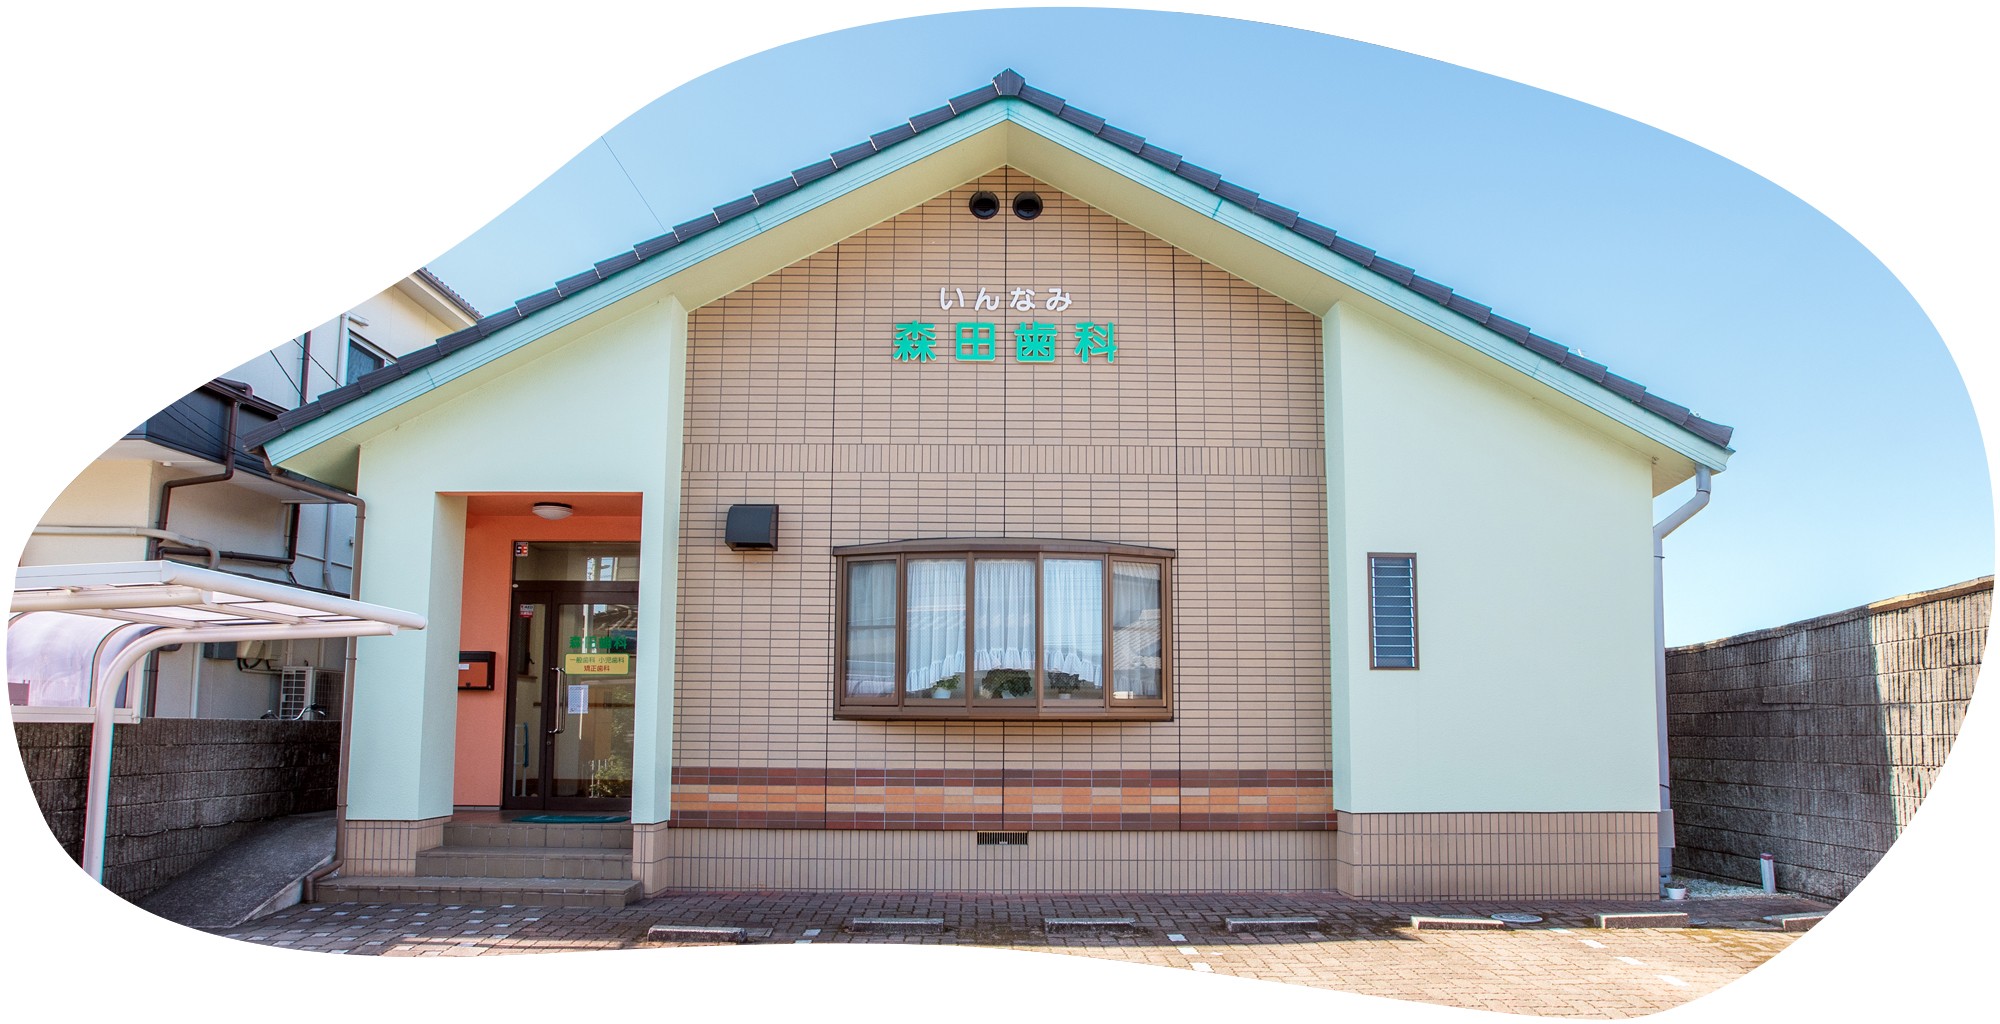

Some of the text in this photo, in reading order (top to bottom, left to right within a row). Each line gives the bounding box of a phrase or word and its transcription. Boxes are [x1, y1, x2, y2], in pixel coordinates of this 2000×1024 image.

[940, 287, 1072, 312] いんなみ
[893, 320, 1118, 363] 森田歯科
[569, 635, 627, 649] 森田歯科
